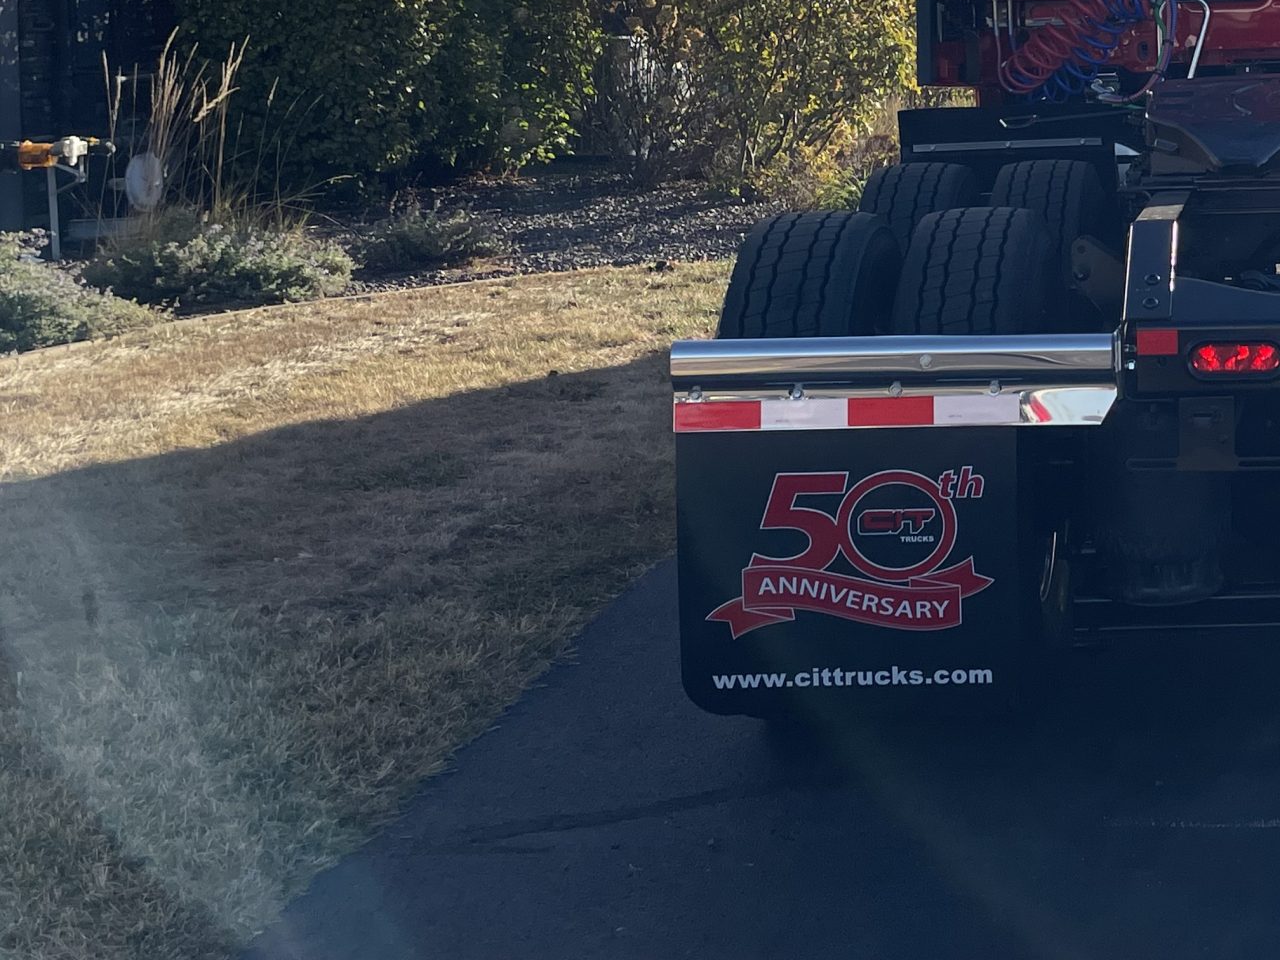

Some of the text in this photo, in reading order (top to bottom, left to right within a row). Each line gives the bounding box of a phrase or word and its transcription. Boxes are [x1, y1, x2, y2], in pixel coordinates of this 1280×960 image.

[900, 535, 935, 543] TRUCKS
[758, 576, 950, 619] ANNIVERSARY
[712, 665, 993, 690] www.cittrucks.com
